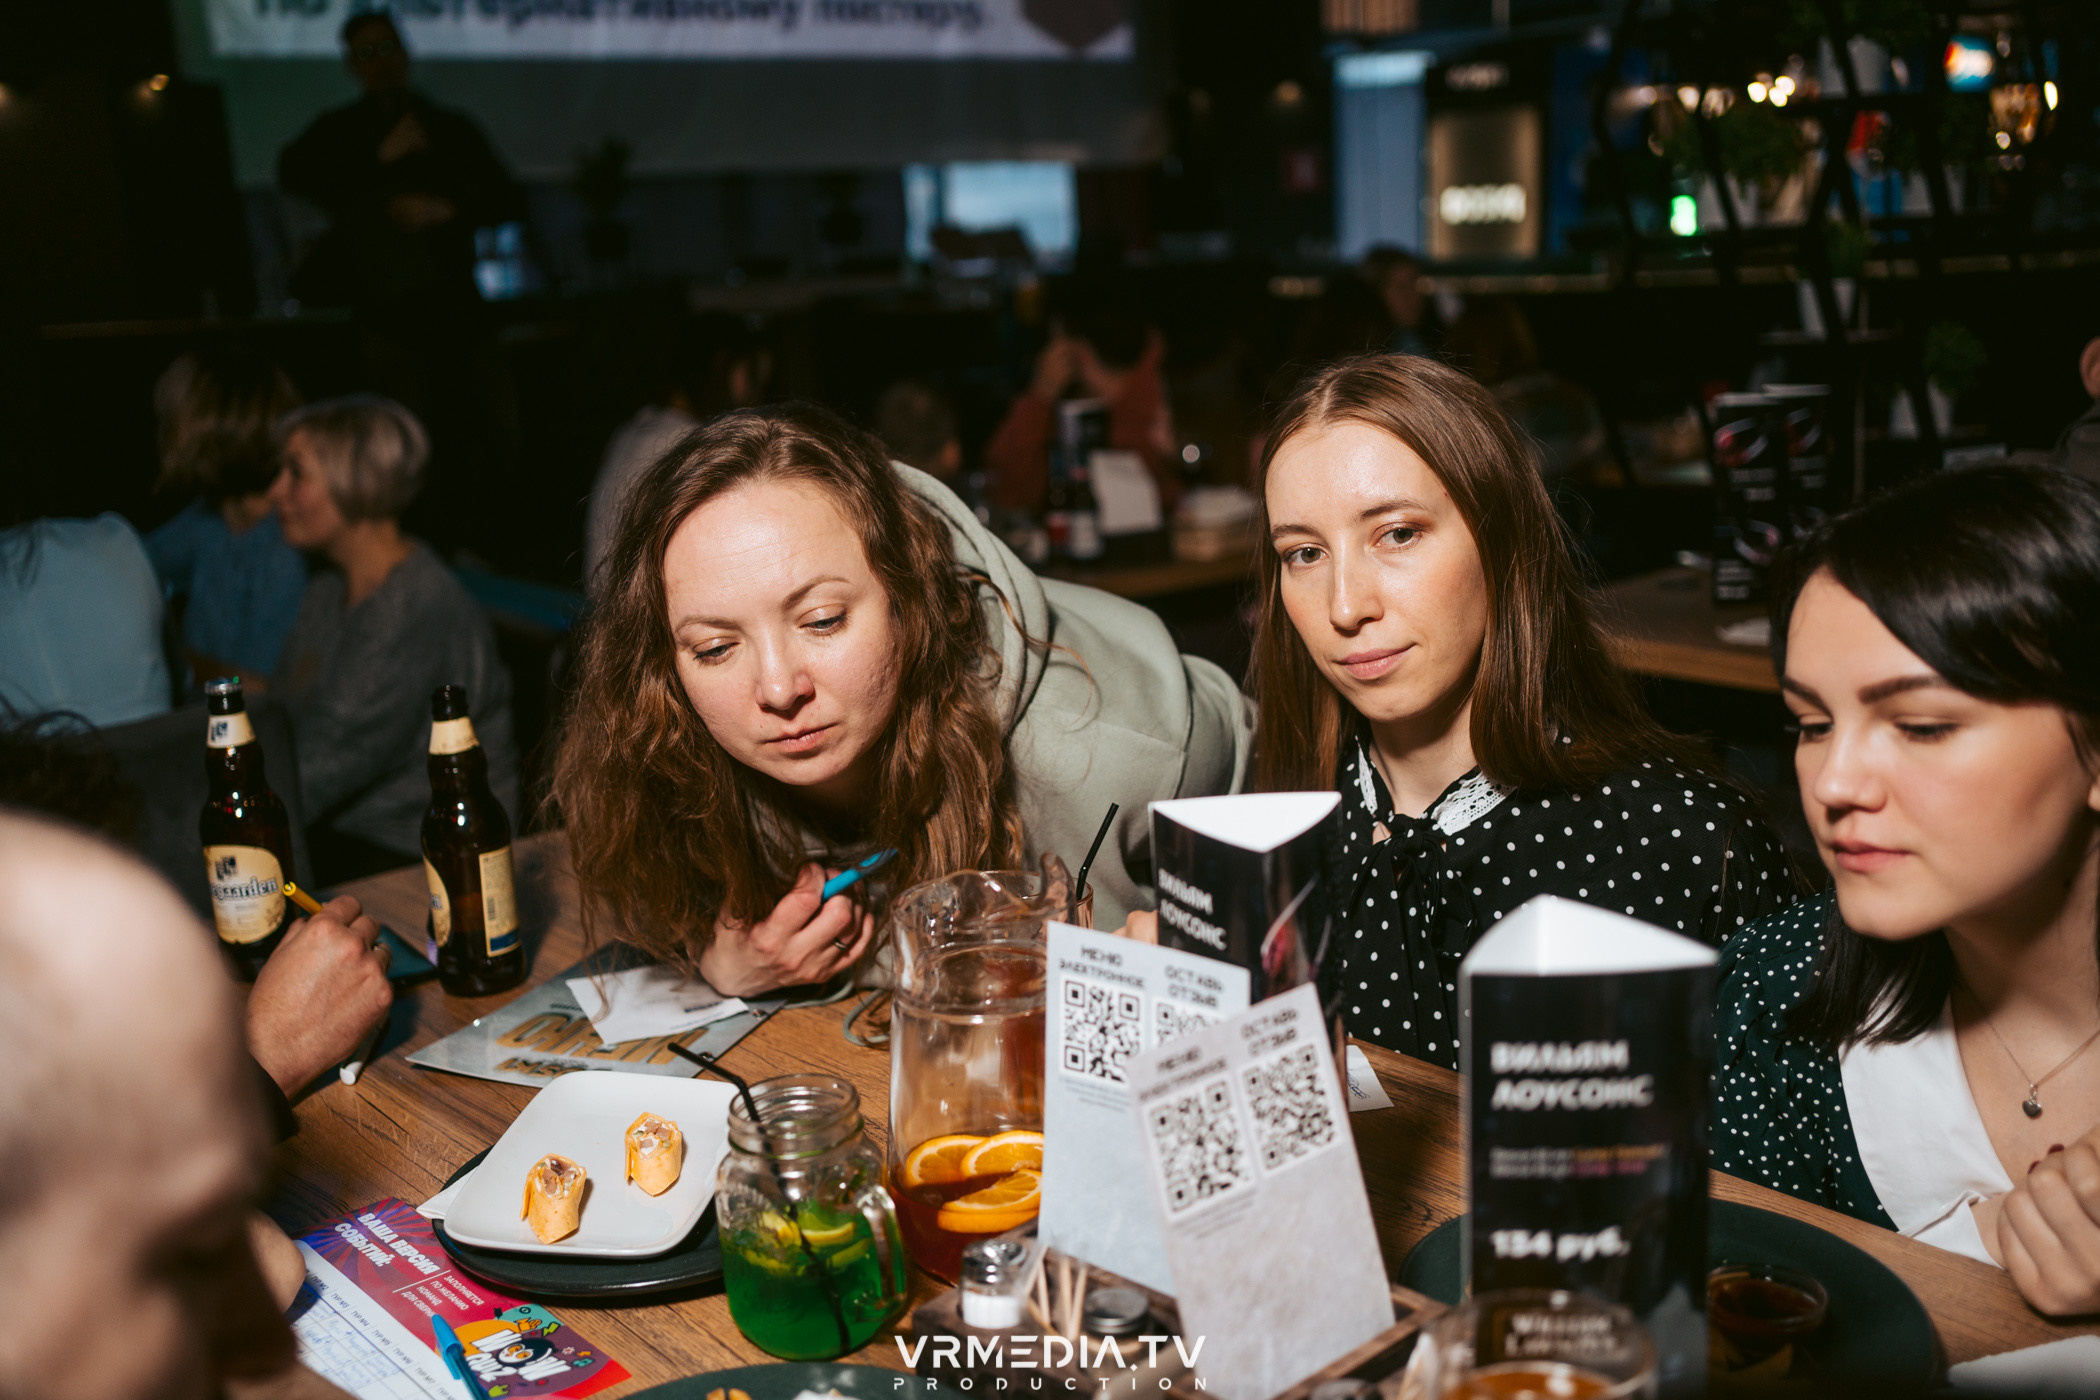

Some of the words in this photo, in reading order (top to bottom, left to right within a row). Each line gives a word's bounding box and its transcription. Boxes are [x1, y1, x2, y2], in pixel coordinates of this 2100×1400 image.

[1491, 1074, 1655, 1111] ЛОУСОНС
[334, 1222, 395, 1267] СОБЫТИЙ:
[357, 1212, 398, 1244] ВАША
[390, 1239, 440, 1275] ВЕРСИЯ
[416, 1286, 443, 1307] КОМАНД
[430, 1280, 442, 1290] ПО
[440, 1287, 469, 1310] ЖЕЛАНИЮ
[444, 1275, 485, 1306] ЗАПОЛНЯЕТСЯ
